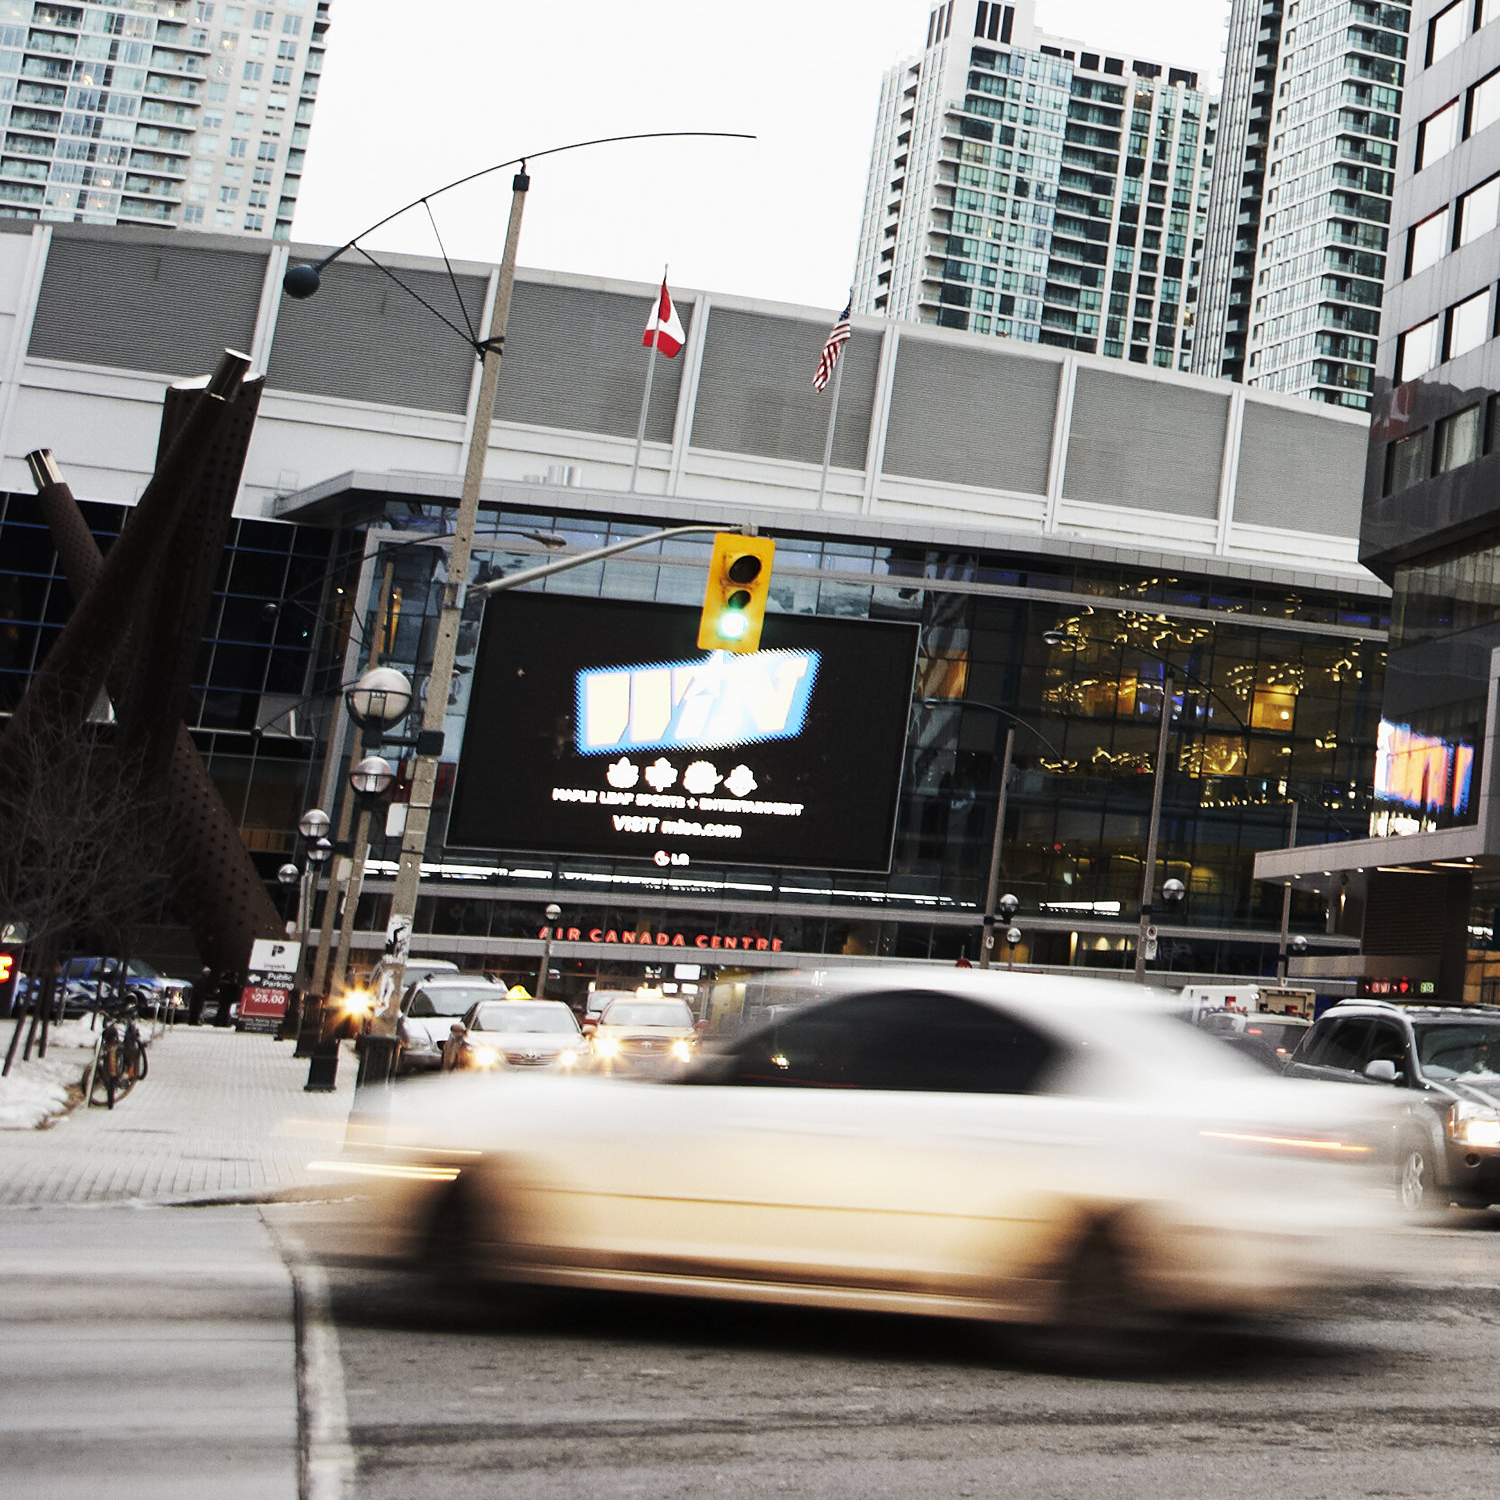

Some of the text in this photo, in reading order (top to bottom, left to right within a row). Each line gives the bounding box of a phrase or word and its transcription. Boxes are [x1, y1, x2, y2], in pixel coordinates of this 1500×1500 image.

[600, 791, 634, 806] LEAF
[612, 814, 660, 834] VISIT
[539, 926, 783, 952] AIR CANADA CENTRE
[267, 972, 293, 981] Public
[262, 980, 295, 991] Parking
